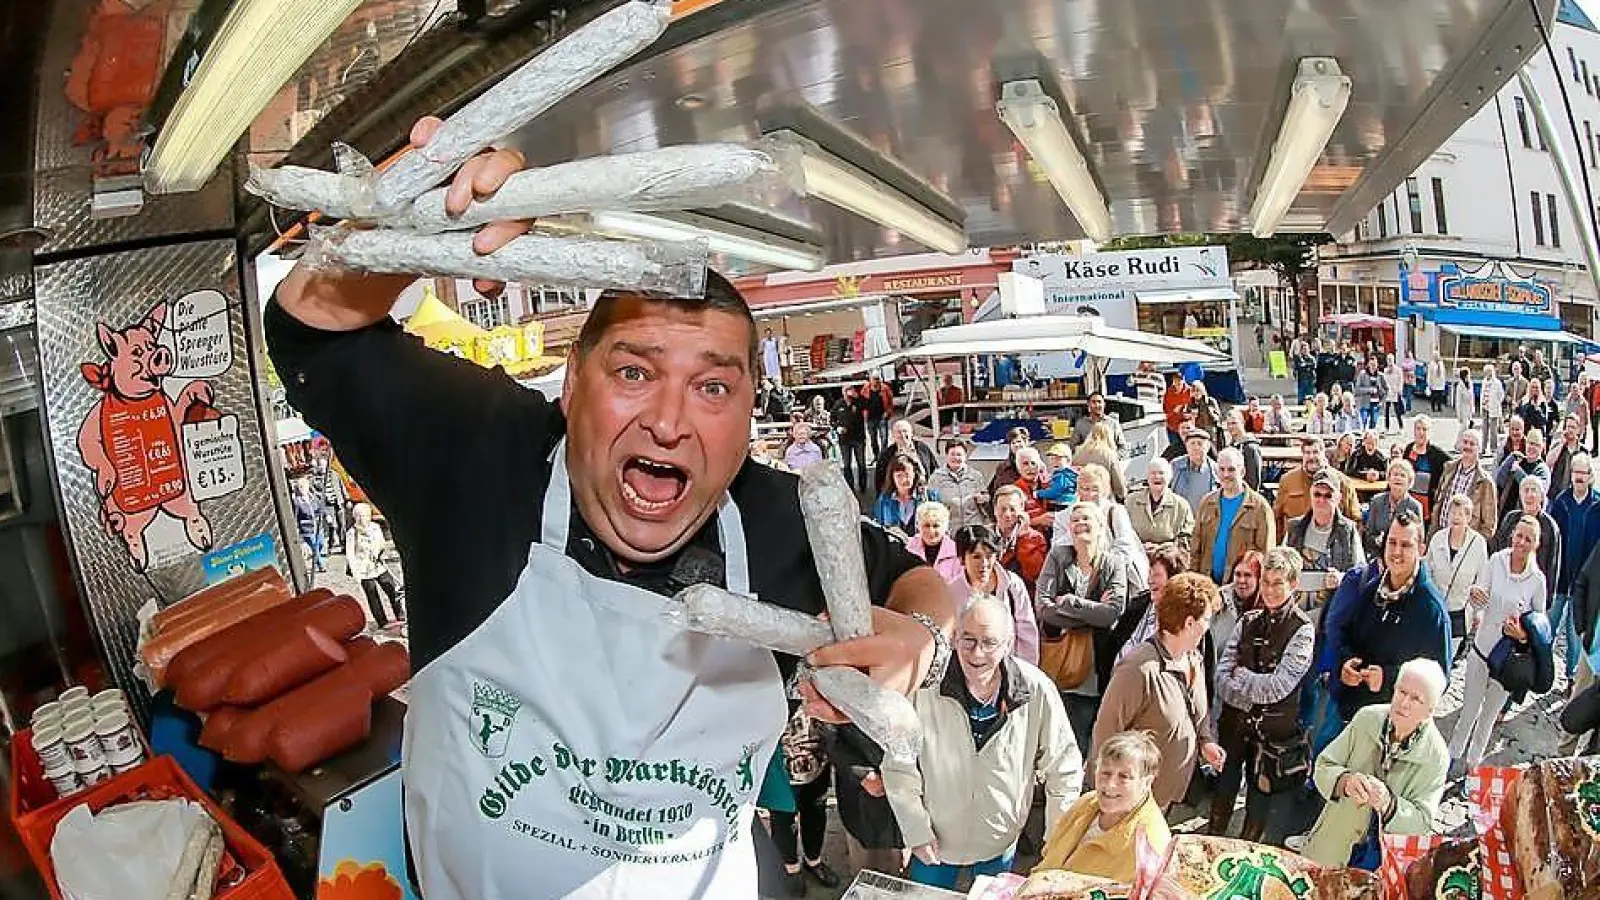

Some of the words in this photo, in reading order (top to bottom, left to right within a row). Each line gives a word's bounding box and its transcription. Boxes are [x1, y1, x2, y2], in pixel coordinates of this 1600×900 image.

[1064, 260, 1120, 280] Käse
[1127, 255, 1181, 276] Rudi
[884, 274, 964, 291] RESTAURANT
[1052, 289, 1125, 304] International
[178, 301, 195, 316] Die
[179, 333, 224, 354] Sprenger
[479, 755, 548, 820] Gilde
[657, 801, 694, 824] 1970
[512, 819, 577, 850] SPEZIAL
